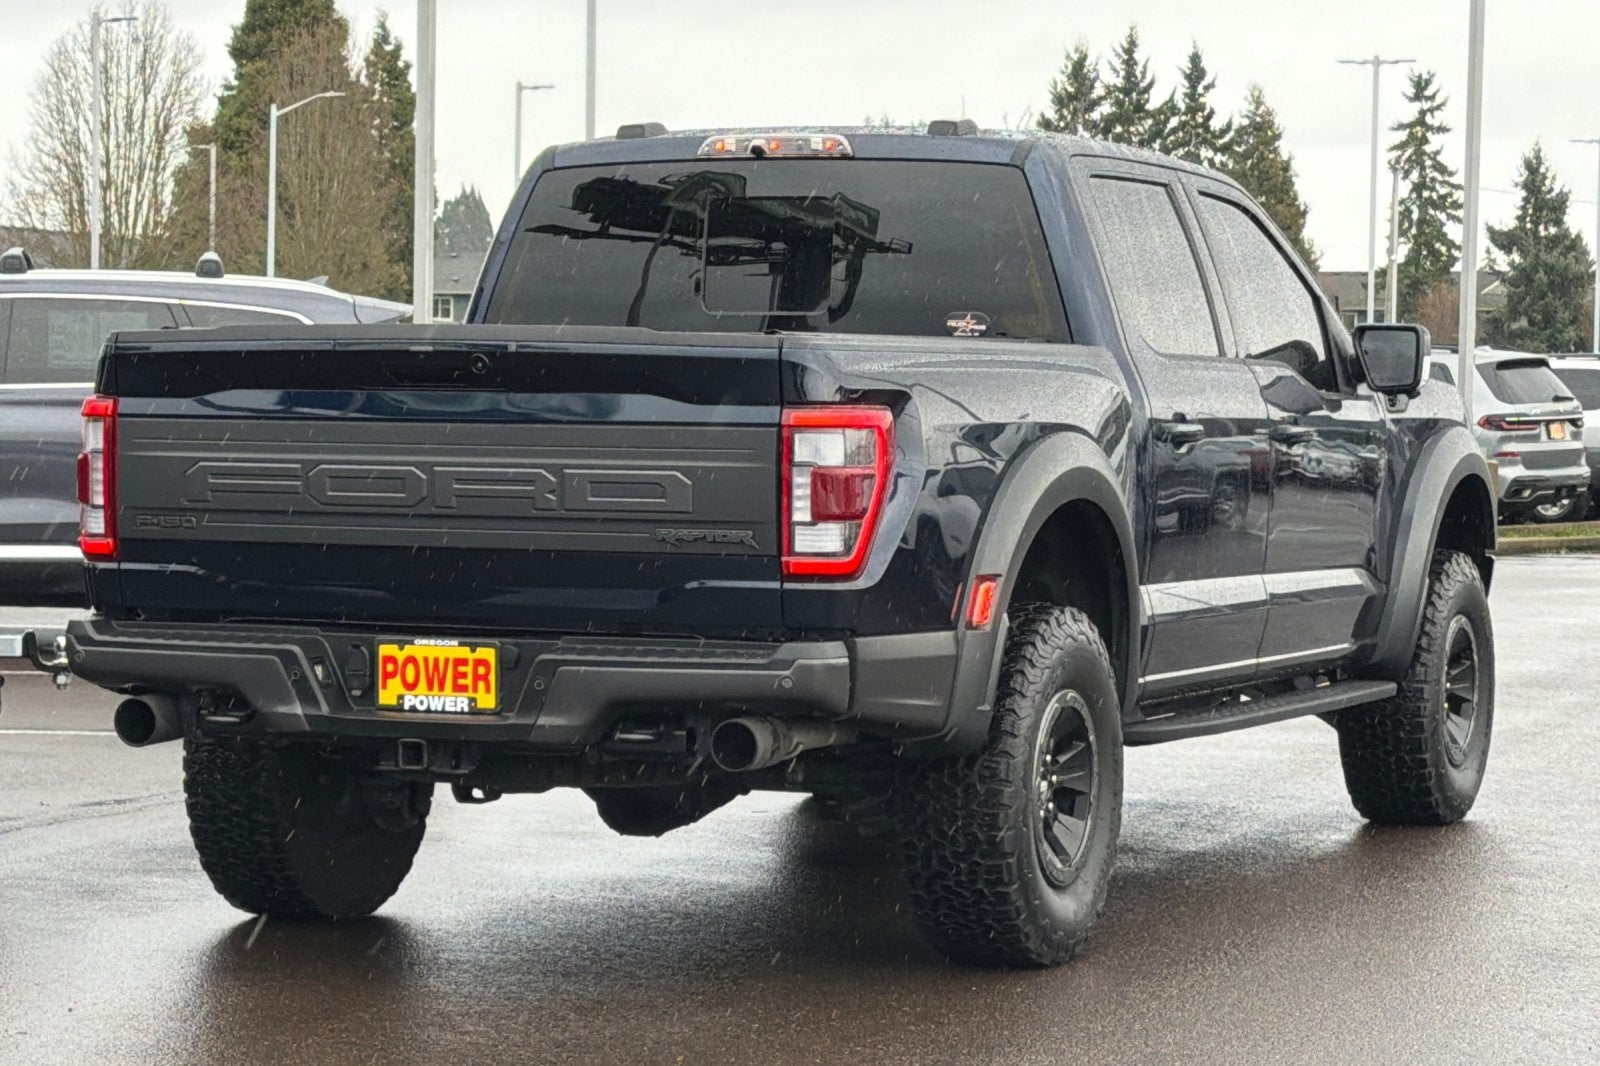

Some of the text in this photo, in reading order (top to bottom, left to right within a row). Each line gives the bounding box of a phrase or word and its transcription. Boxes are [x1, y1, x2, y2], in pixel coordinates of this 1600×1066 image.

[183, 461, 692, 514] FORD
[655, 528, 759, 549] RAPTOR
[414, 638, 459, 646] OREGON
[381, 655, 491, 693] POWER
[403, 694, 469, 712] POWER
